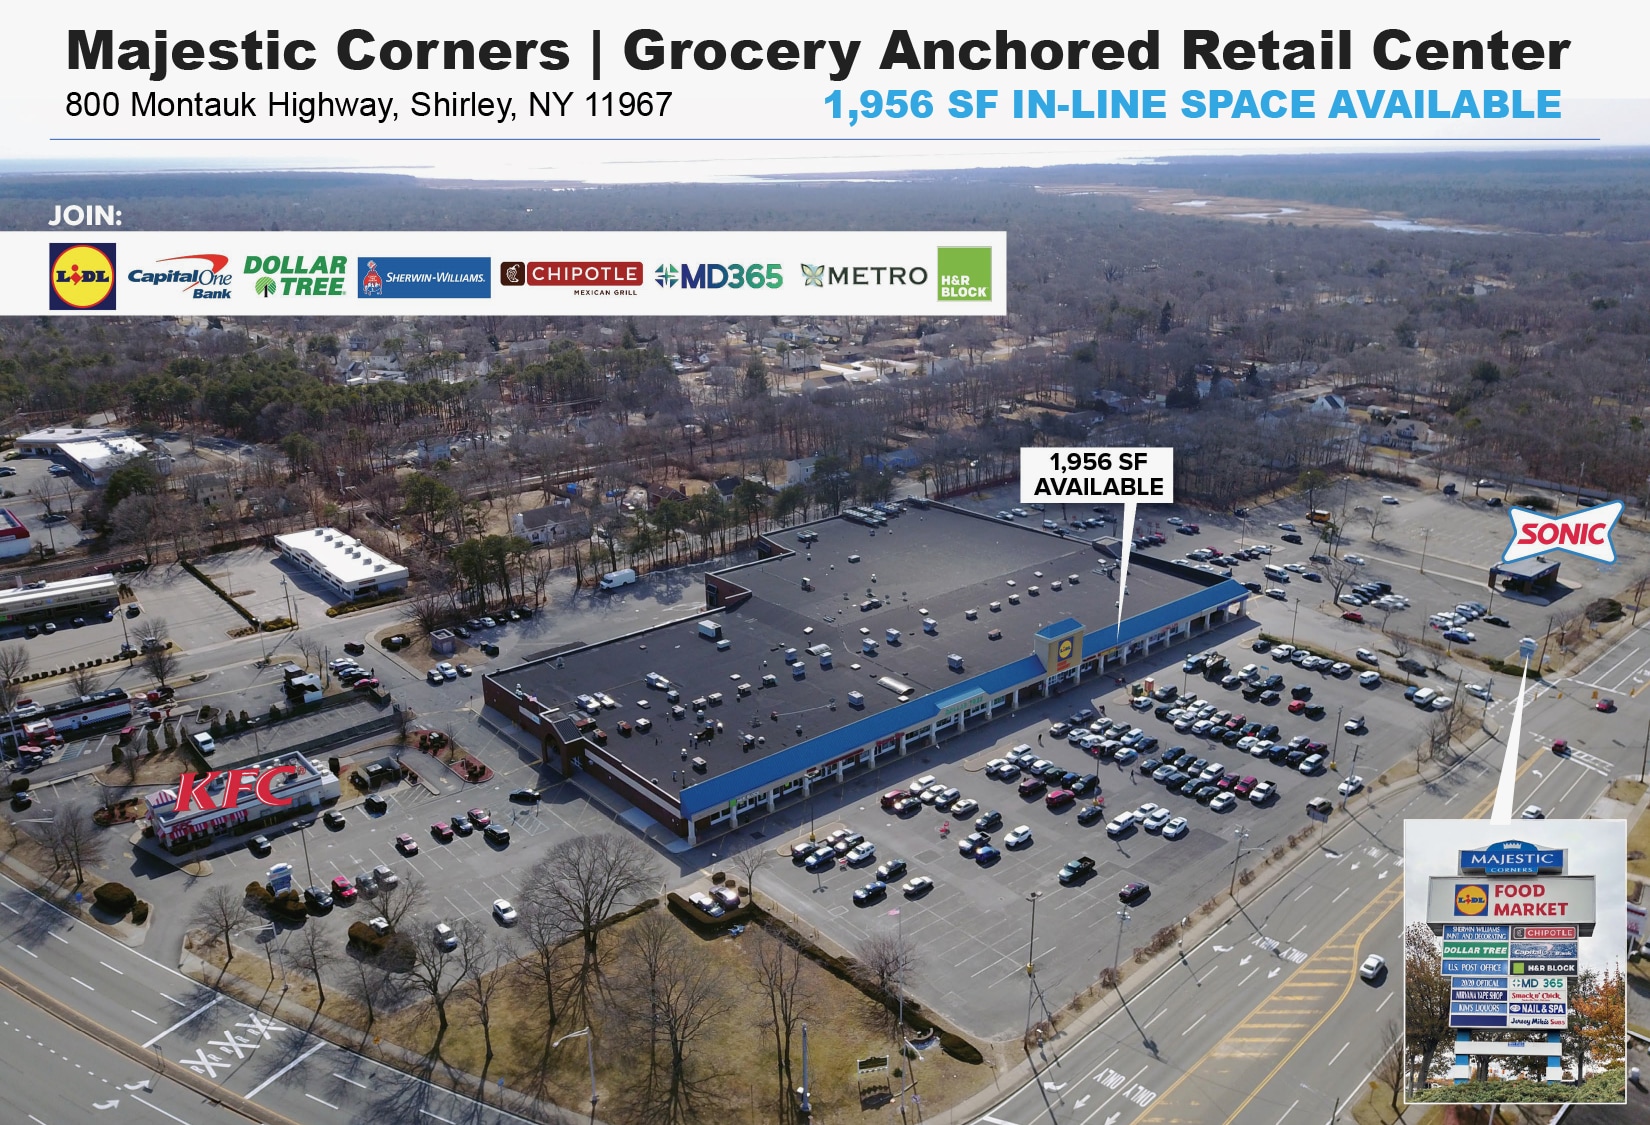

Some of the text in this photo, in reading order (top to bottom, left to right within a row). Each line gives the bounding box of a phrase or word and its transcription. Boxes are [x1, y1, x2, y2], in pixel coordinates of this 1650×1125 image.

[1471, 853, 1554, 865] MAJESTIC
[1494, 884, 1545, 898] FOOD
[1494, 902, 1569, 917] MARKET
[1527, 929, 1573, 937] CHIPOTLE
[1443, 946, 1507, 954] DOLLAR TREE
[1461, 963, 1477, 971] POST
[1480, 963, 1501, 971] OFFICE
[1527, 964, 1575, 972] H&R BLOCK
[1475, 979, 1499, 987] OPTICAL
[1521, 978, 1563, 988] MD 365
[1477, 991, 1489, 999] VAPE
[1489, 991, 1503, 999] SHOP
[1475, 1003, 1500, 1012] LIQUORS
[1521, 1004, 1540, 1013] NAIL
[1541, 1004, 1548, 1013] &
[1548, 1004, 1564, 1013] SPA
[1092, 1067, 1157, 1108] ONLY ONLY
